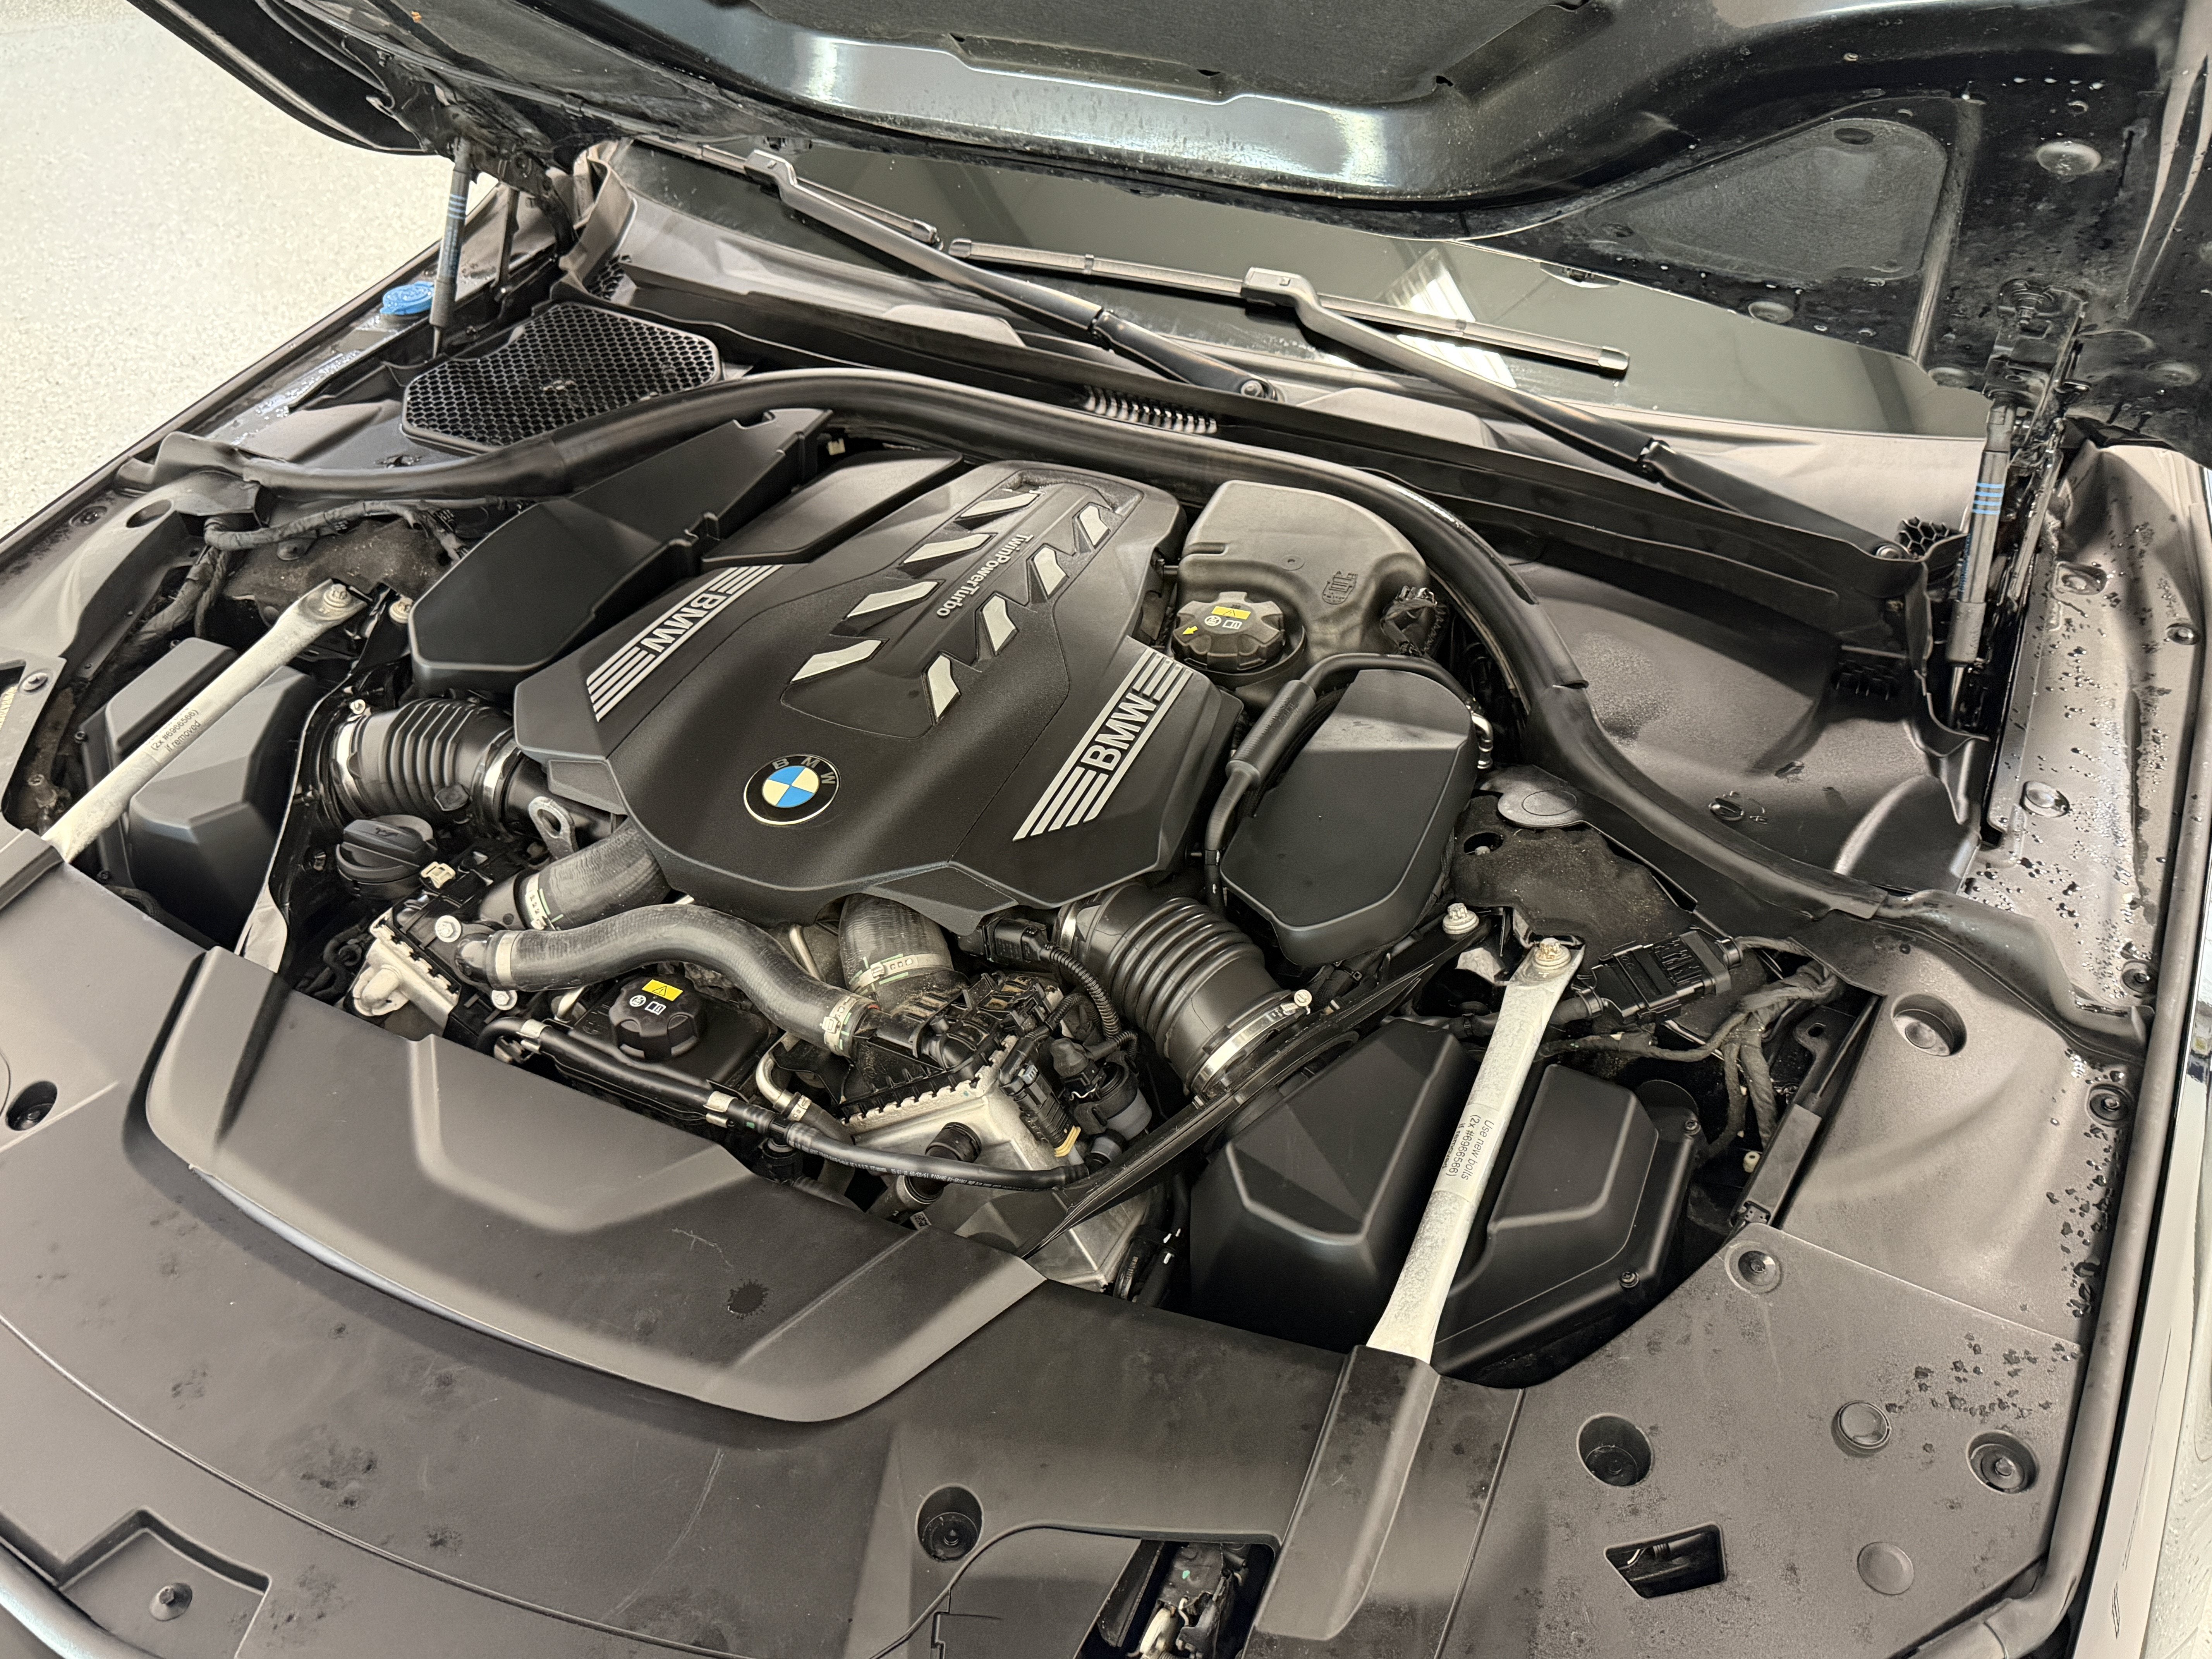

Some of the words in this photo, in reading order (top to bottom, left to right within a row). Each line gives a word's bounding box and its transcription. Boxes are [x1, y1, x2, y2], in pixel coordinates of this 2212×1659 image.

[936, 533, 1034, 617] TwinPowerTurbo
[641, 593, 727, 653] BMW
[151, 740, 164, 750] (2x
[172, 720, 201, 747] removed
[1081, 692, 1157, 771] BMW
[772, 757, 836, 784] BMW
[1467, 1115, 1481, 1128] (2x
[1480, 1120, 1494, 1138] Use
[1446, 1130, 1475, 1176] #6966566)
[1471, 1139, 1484, 1158] new
[1461, 1158, 1478, 1180] bolts
